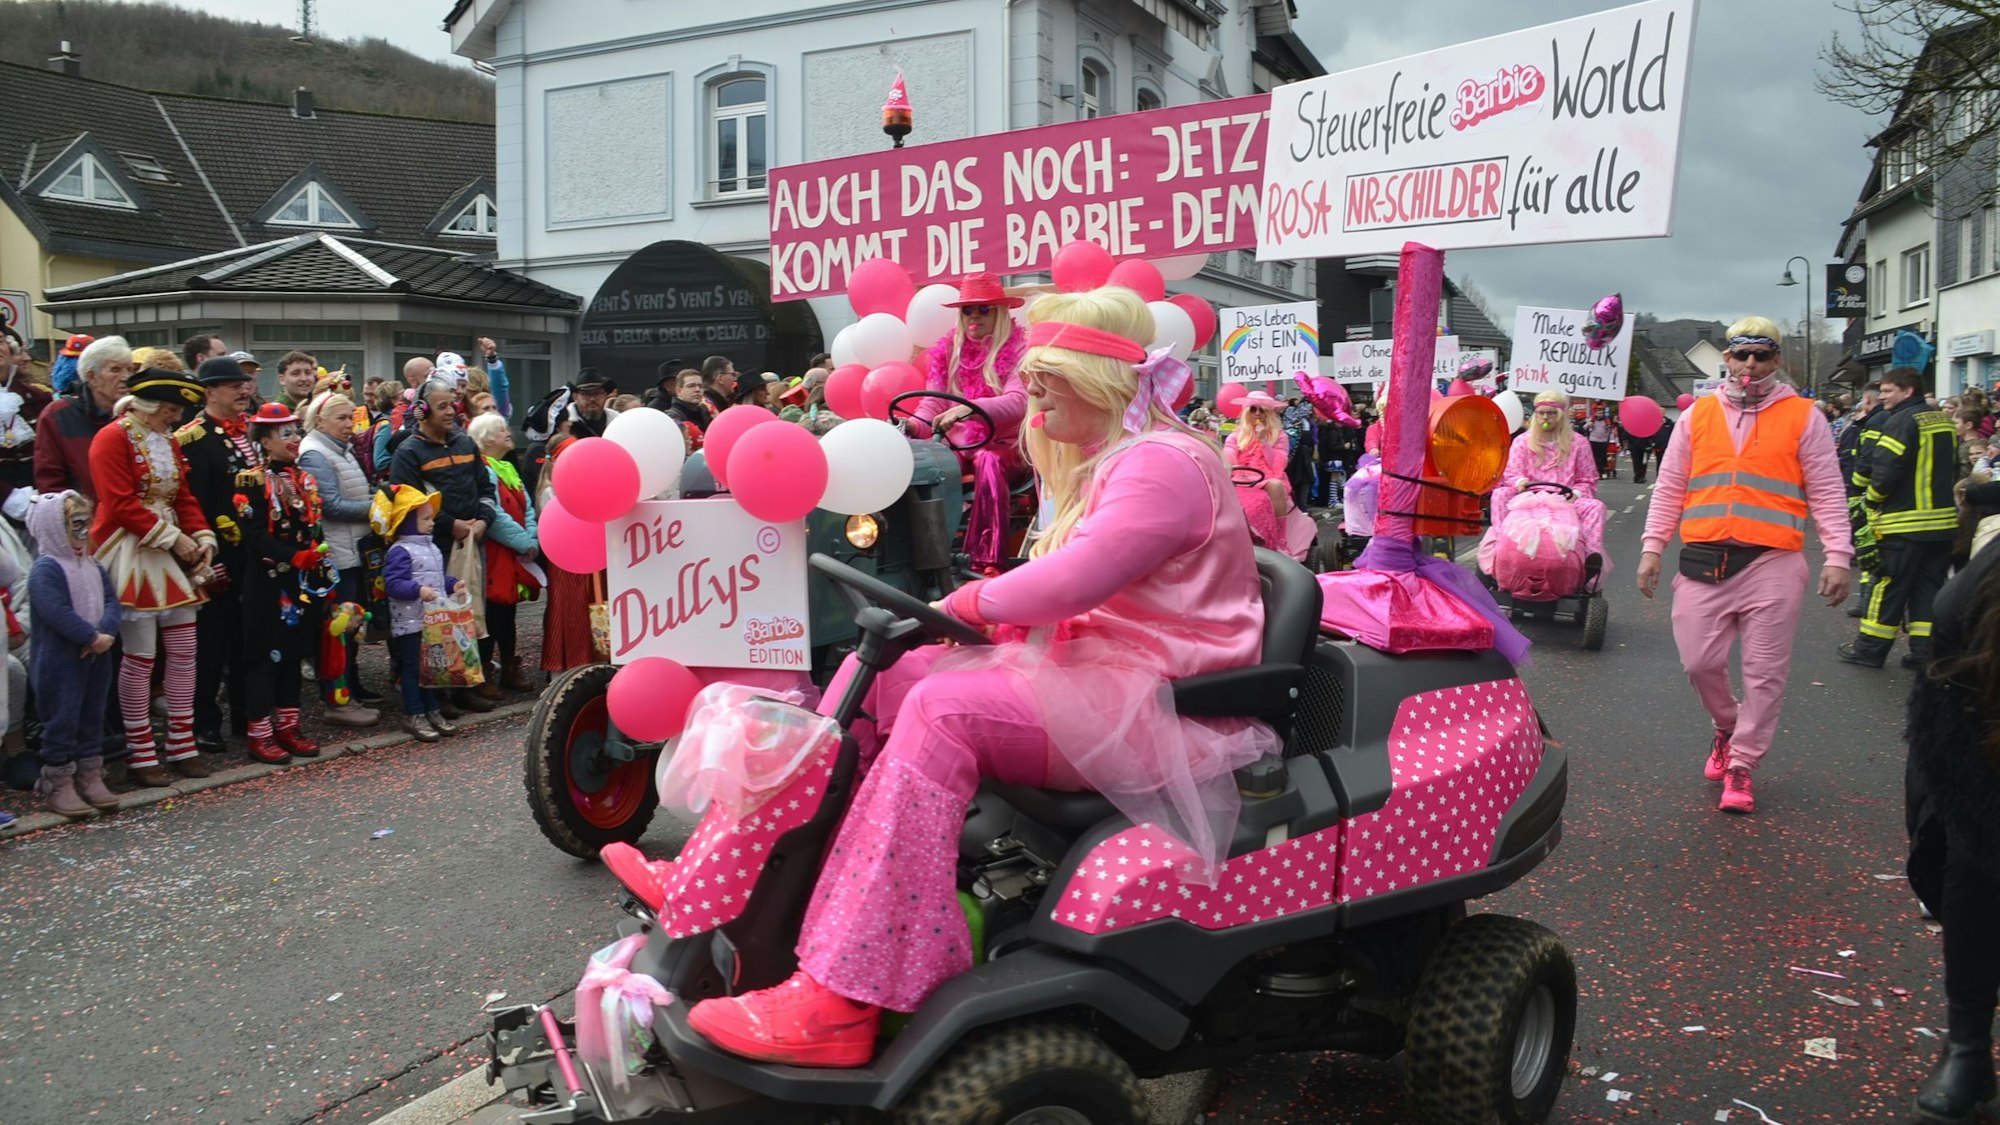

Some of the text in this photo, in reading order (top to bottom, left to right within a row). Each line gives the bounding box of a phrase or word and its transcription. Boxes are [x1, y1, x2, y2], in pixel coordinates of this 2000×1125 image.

[1290, 11, 1675, 162] Steuerfreie Barbie World
[772, 110, 1270, 232] AUCH DAS NOCH: JETZ
[1266, 179, 1332, 245] ROSA
[1507, 155, 1559, 231] für
[1565, 147, 1640, 214] alle
[772, 228, 907, 295] KOMMT
[926, 218, 986, 277] DIE
[728, 289, 756, 307] VEN
[1236, 309, 1297, 328] Das Leben
[1532, 311, 1575, 336] Make
[581, 329, 608, 345] ELTA
[1247, 329, 1297, 349] ist EIN
[1362, 344, 1392, 358] Ohne
[1539, 338, 1617, 368] REPUBLIK
[1226, 354, 1283, 380] Ponyhof
[1337, 365, 1363, 378] stirbt
[1368, 365, 1384, 377] die
[1515, 364, 1549, 388] pink
[624, 515, 684, 568] Die
[612, 553, 760, 657] Dullys
[744, 617, 804, 645] Barbie
[749, 648, 804, 664] EDITION
